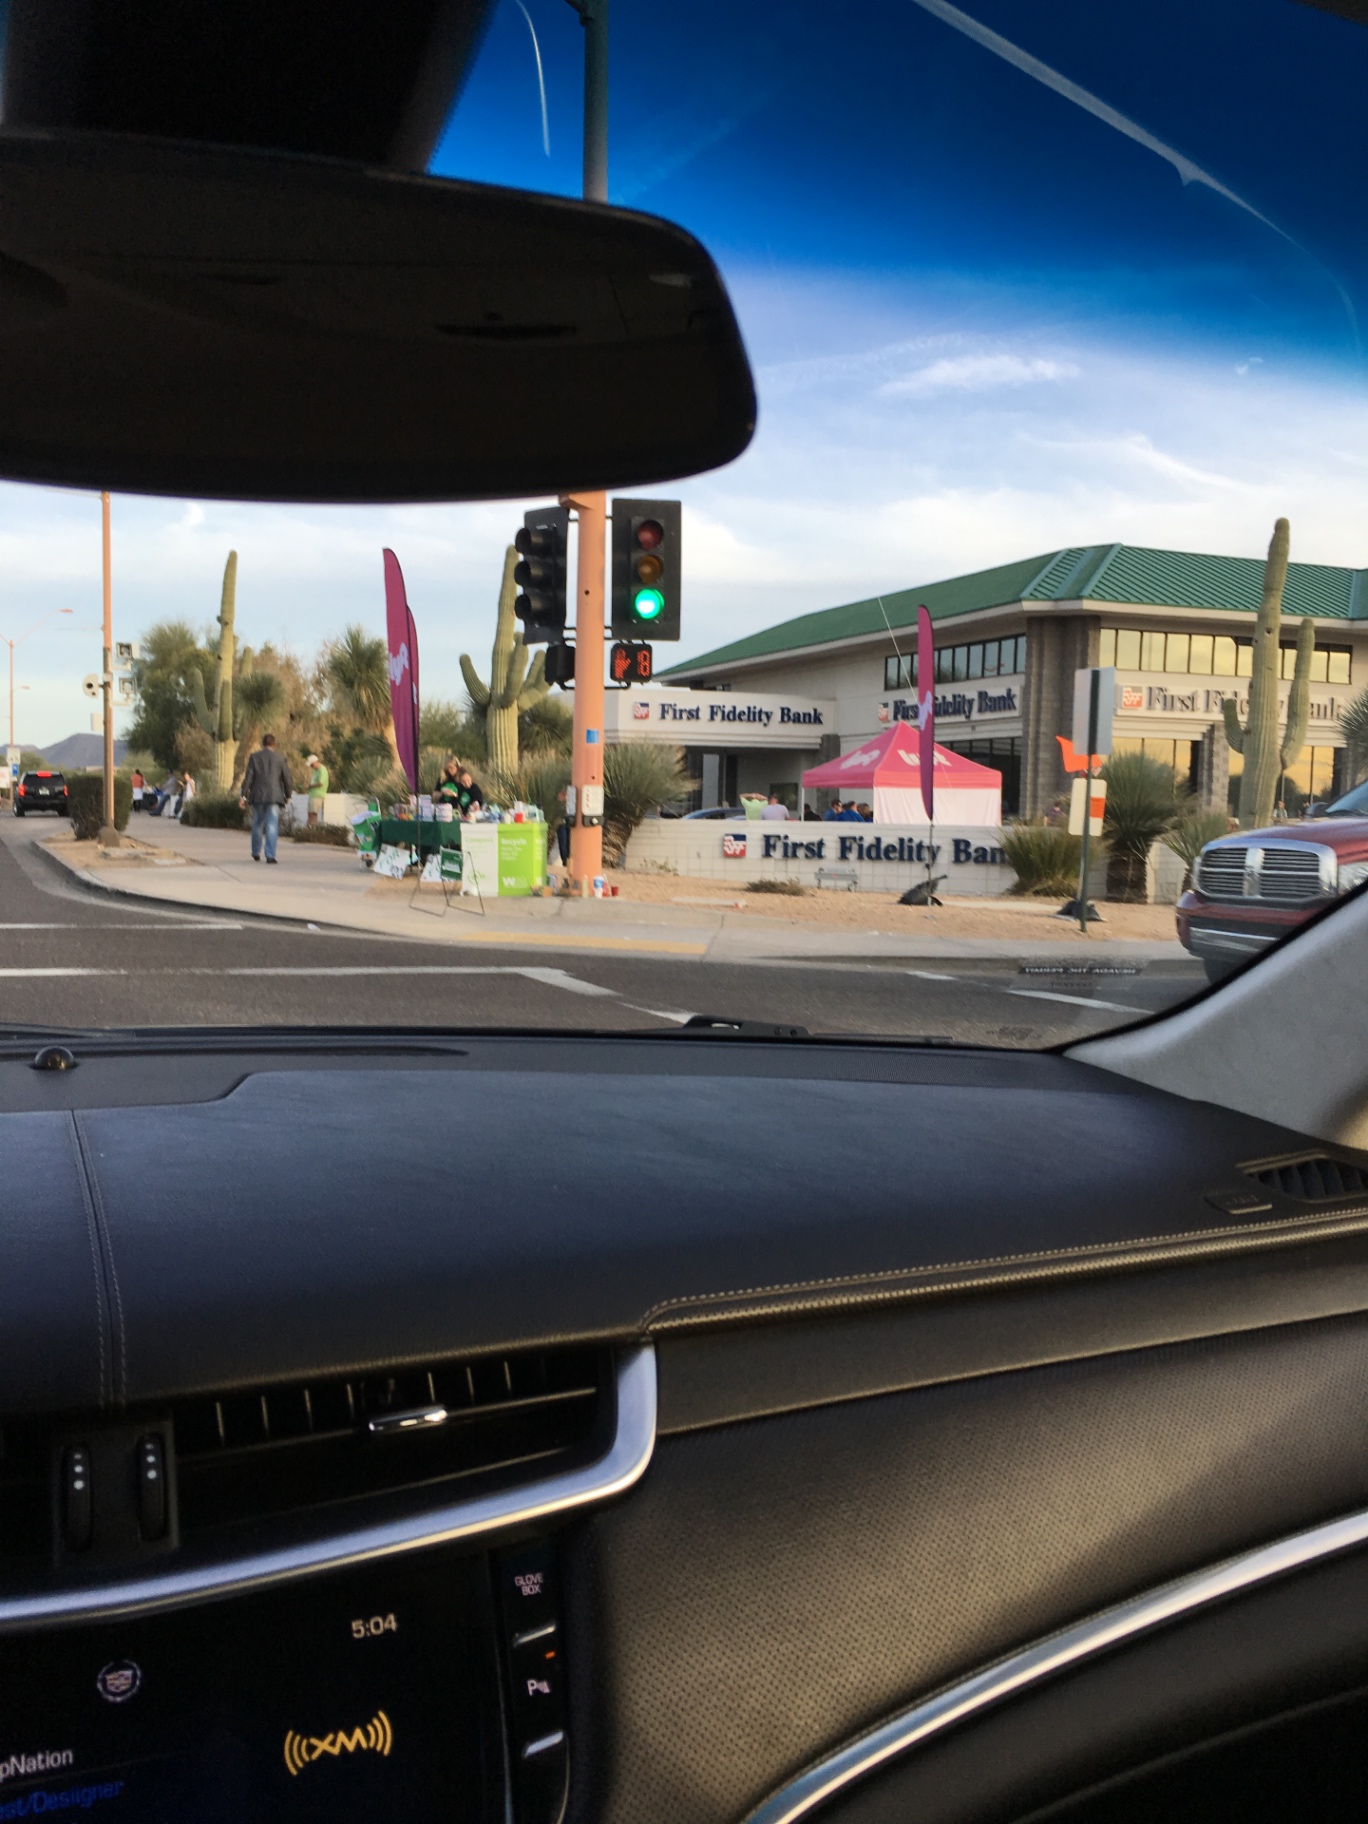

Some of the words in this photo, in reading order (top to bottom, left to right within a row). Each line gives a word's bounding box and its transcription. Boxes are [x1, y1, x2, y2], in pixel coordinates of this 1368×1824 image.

[636, 650, 650, 677] 8
[893, 699, 919, 721] Firs
[934, 693, 975, 720] idelity
[977, 687, 1016, 713] Bank
[1146, 686, 1198, 712] First
[660, 703, 701, 721] First
[708, 704, 773, 727] Fidelity
[779, 707, 823, 725] Bank
[762, 834, 826, 859] First
[838, 835, 941, 869] Fidelity
[952, 838, 1007, 865] Ban
[514, 1573, 544, 1587] GLOVE
[521, 1584, 541, 1596] BOX
[351, 1613, 398, 1639] 5:04
